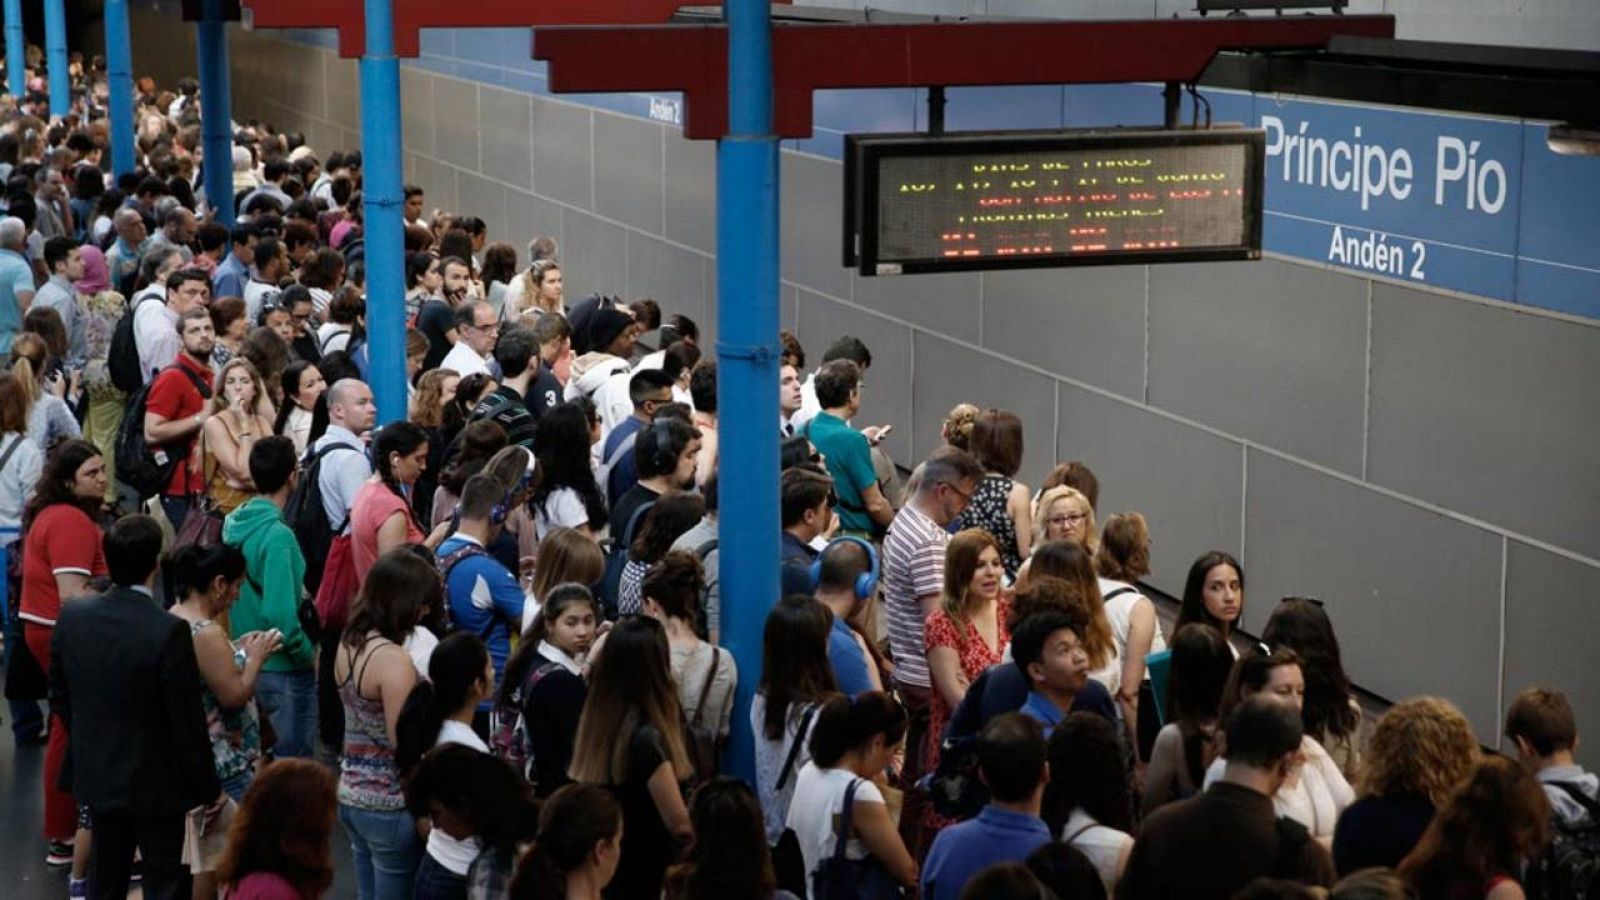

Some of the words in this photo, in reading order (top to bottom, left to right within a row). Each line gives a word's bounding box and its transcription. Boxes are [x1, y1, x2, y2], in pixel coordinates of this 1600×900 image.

[674, 102, 681, 124] 2
[1261, 115, 1414, 211] Príncipe
[1435, 135, 1507, 214] Pío
[1328, 225, 1403, 275] Andén
[1410, 241, 1426, 280] 2
[544, 390, 556, 407] 3
